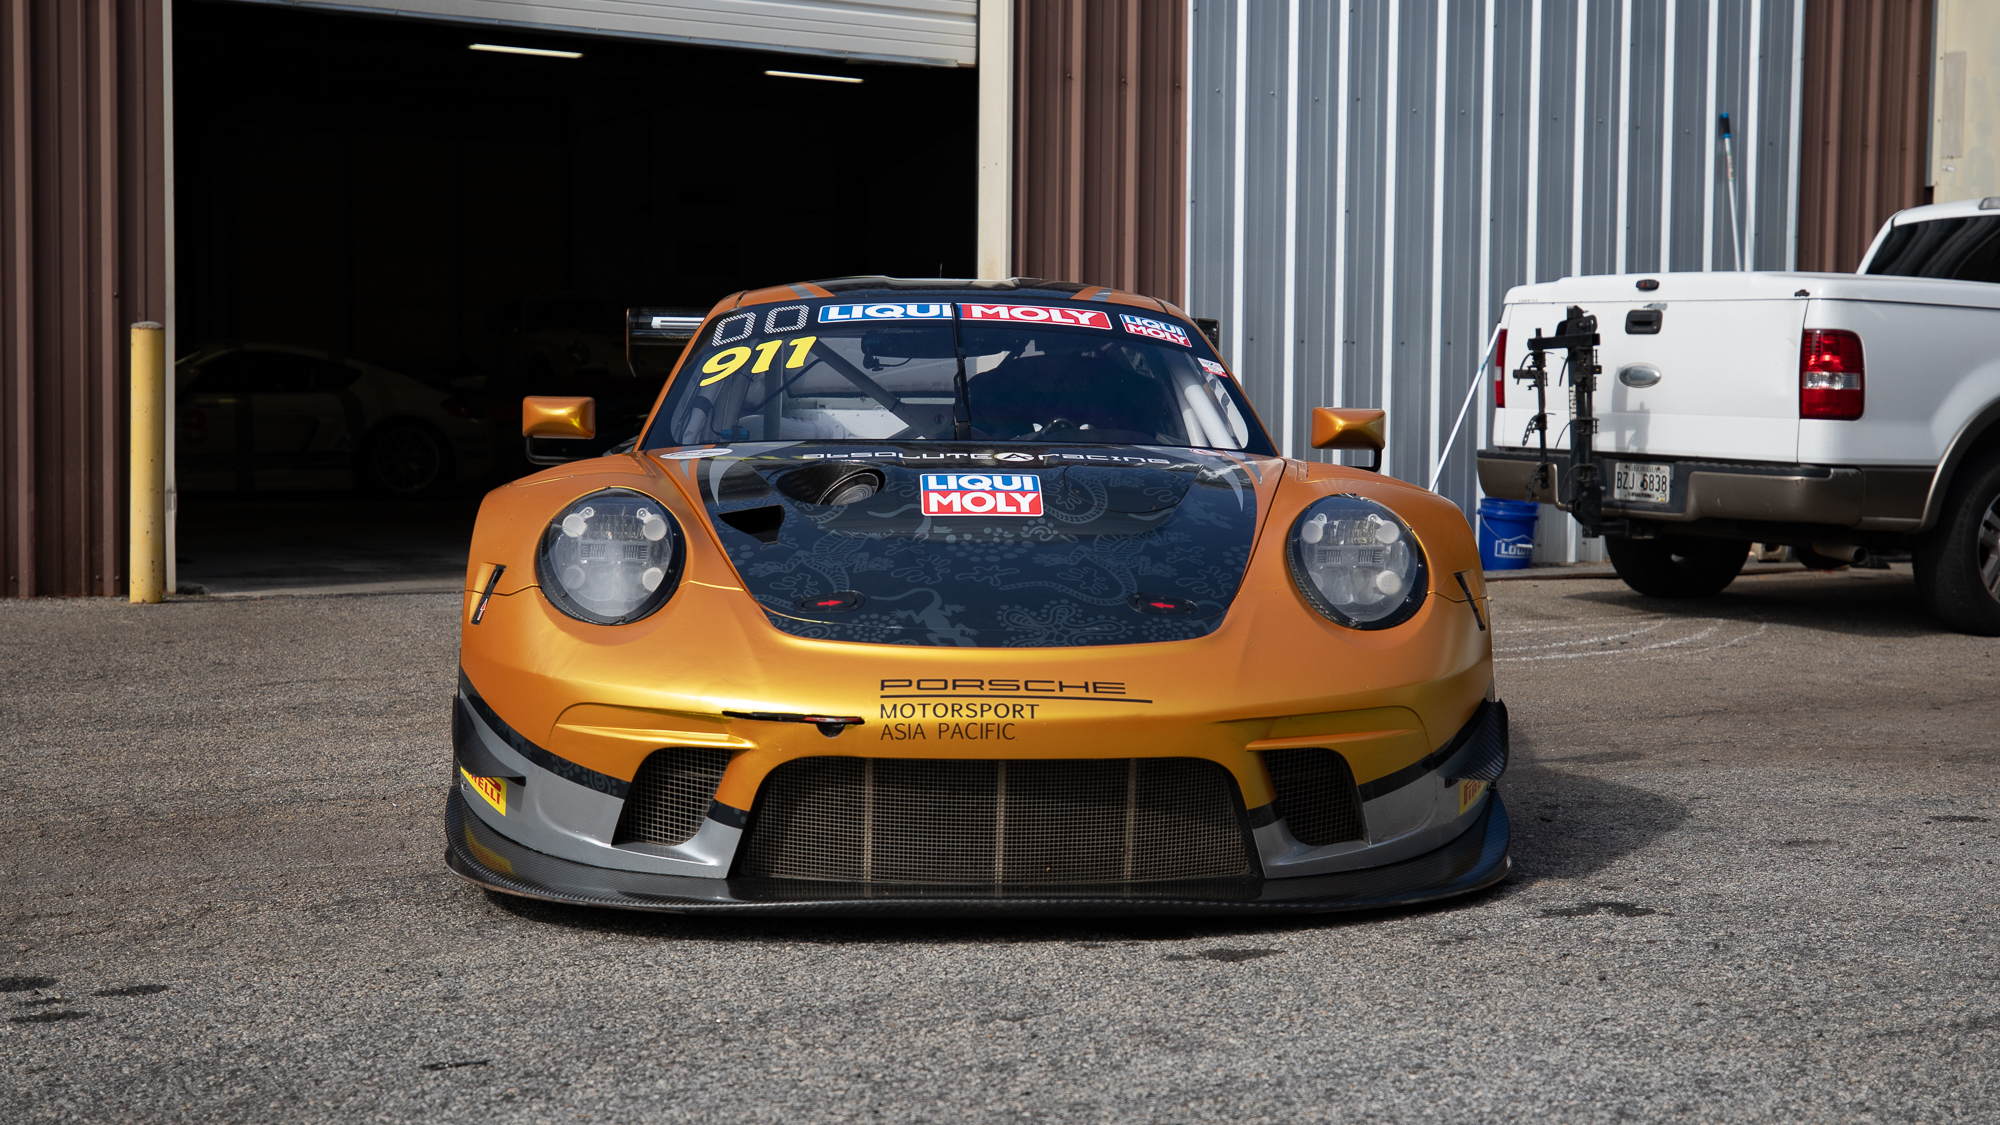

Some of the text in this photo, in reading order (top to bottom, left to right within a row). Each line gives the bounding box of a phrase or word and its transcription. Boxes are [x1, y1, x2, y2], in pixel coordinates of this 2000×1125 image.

[827, 303, 1098, 325] LIQUI MOLY
[1123, 315, 1186, 337] LIQUI
[1127, 323, 1187, 344] MOLY
[699, 335, 817, 387] 911
[927, 474, 1034, 491] LIQUI
[1616, 471, 1668, 492] BZJ 6838
[928, 491, 1039, 513] MOLY
[880, 678, 1127, 695] PORSCHE
[880, 702, 1040, 720] MOTORSPORT
[880, 722, 1017, 741] ASIA PACIFIC
